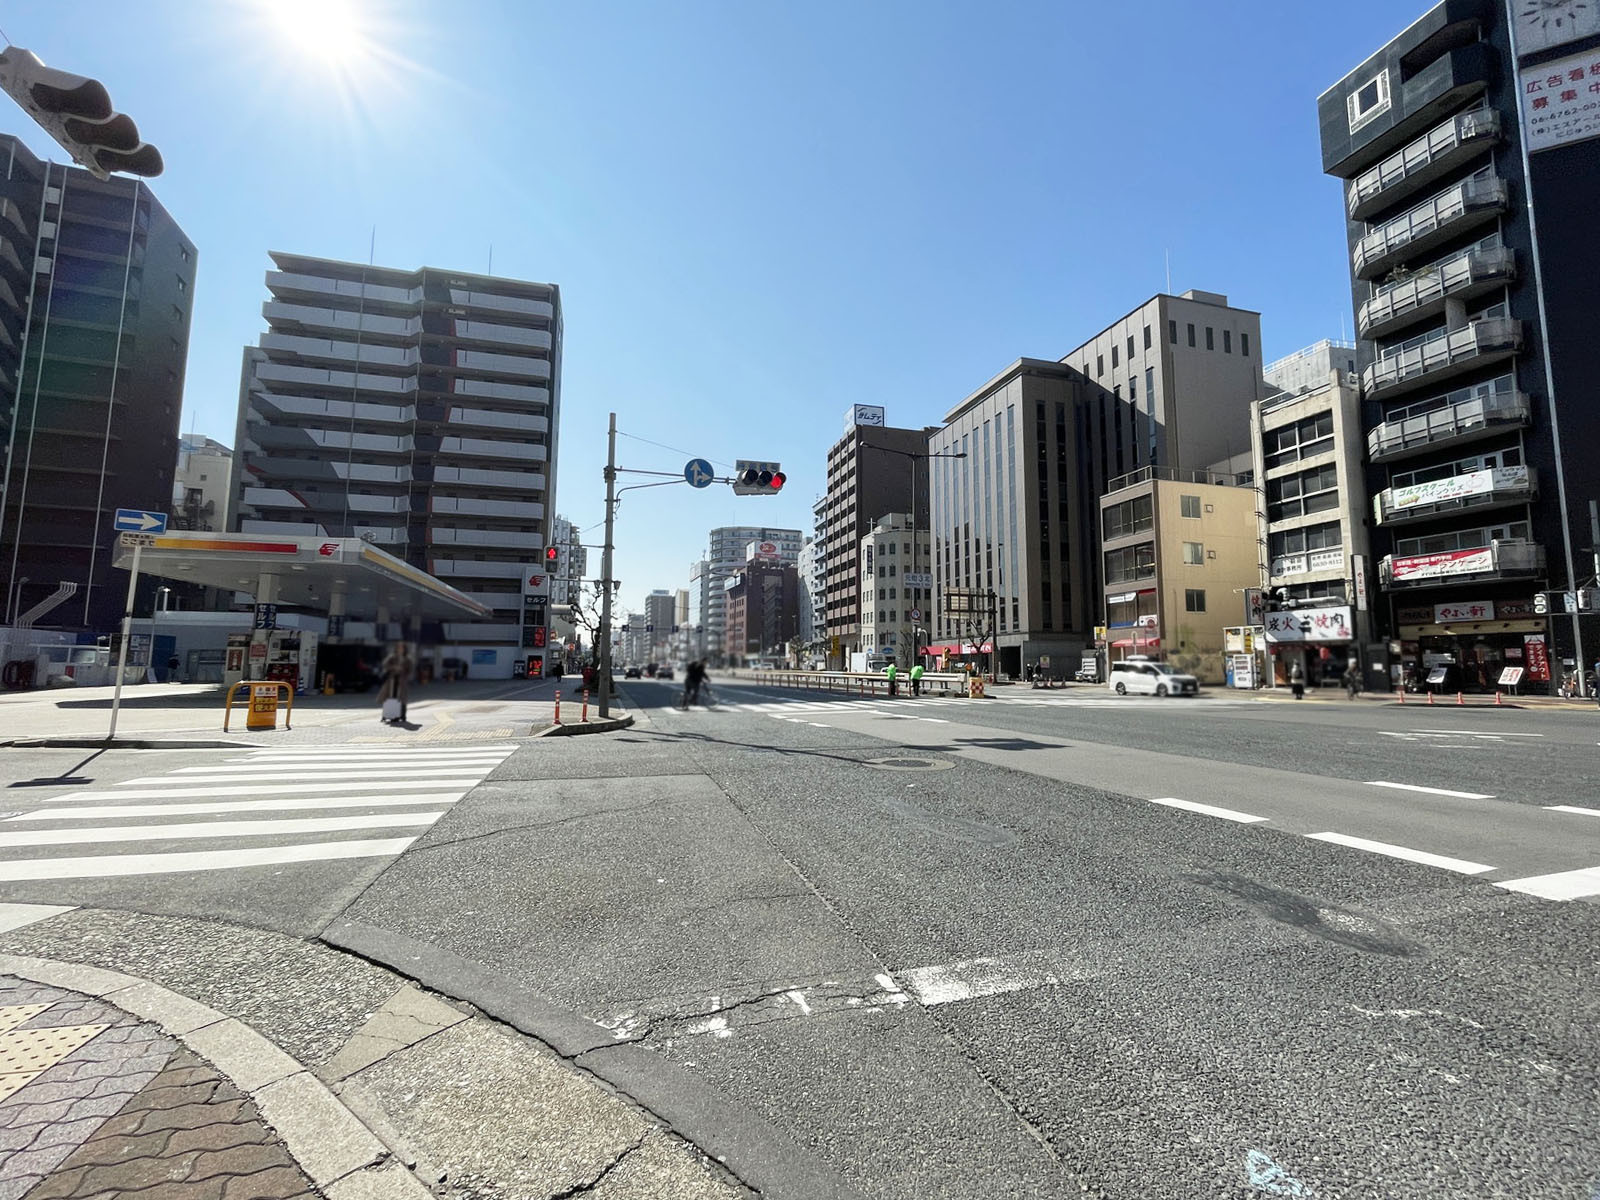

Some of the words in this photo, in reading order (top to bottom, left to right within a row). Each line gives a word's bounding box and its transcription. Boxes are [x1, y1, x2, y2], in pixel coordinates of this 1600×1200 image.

[1398, 479, 1455, 497] ゴルフスクール
[122, 538, 156, 547] ここまで
[258, 604, 267, 628] セルフ
[268, 604, 277, 628] セルフ
[1268, 617, 1294, 632] 炭火
[1315, 613, 1345, 629] 焼肉
[1535, 645, 1546, 679] テイクアウト
